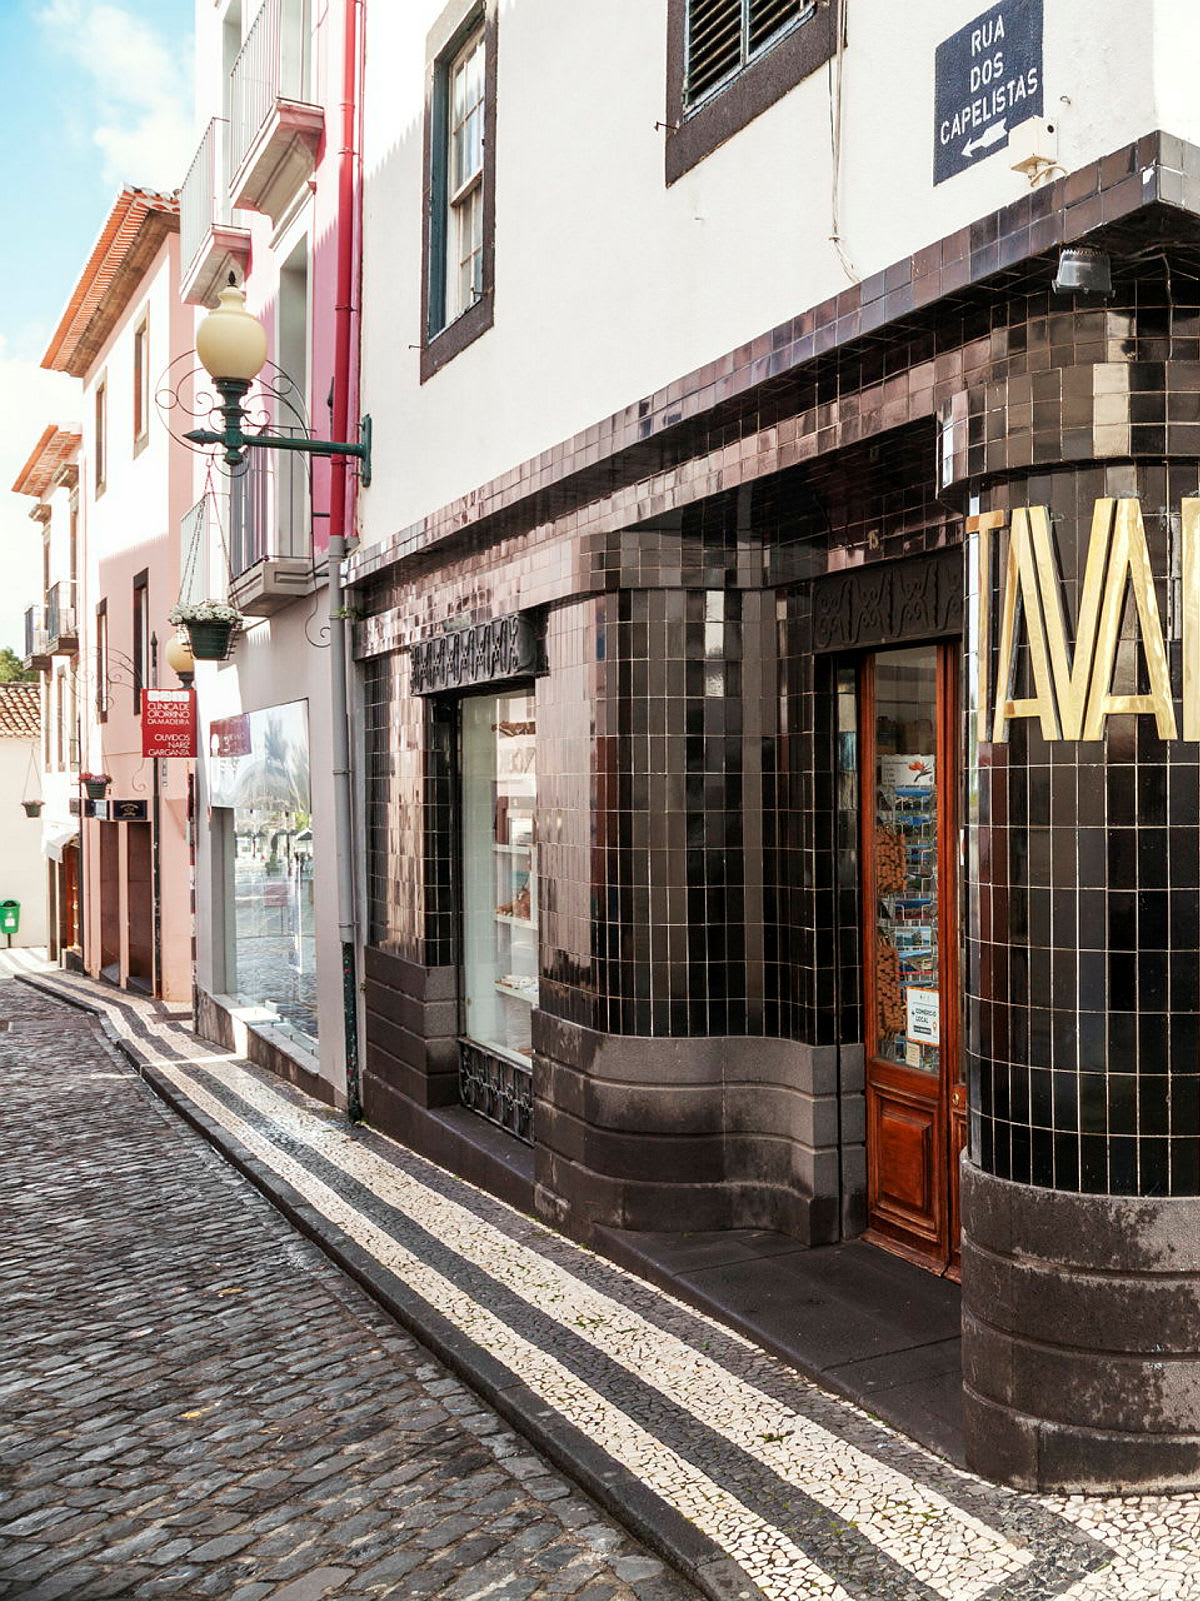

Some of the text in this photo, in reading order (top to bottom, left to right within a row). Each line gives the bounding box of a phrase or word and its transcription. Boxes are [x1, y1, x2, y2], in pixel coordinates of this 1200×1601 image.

[971, 14, 1005, 57] RUA
[970, 52, 1004, 93] DOS
[940, 67, 1039, 145] CAPELISTAS
[179, 703, 190, 711] DE
